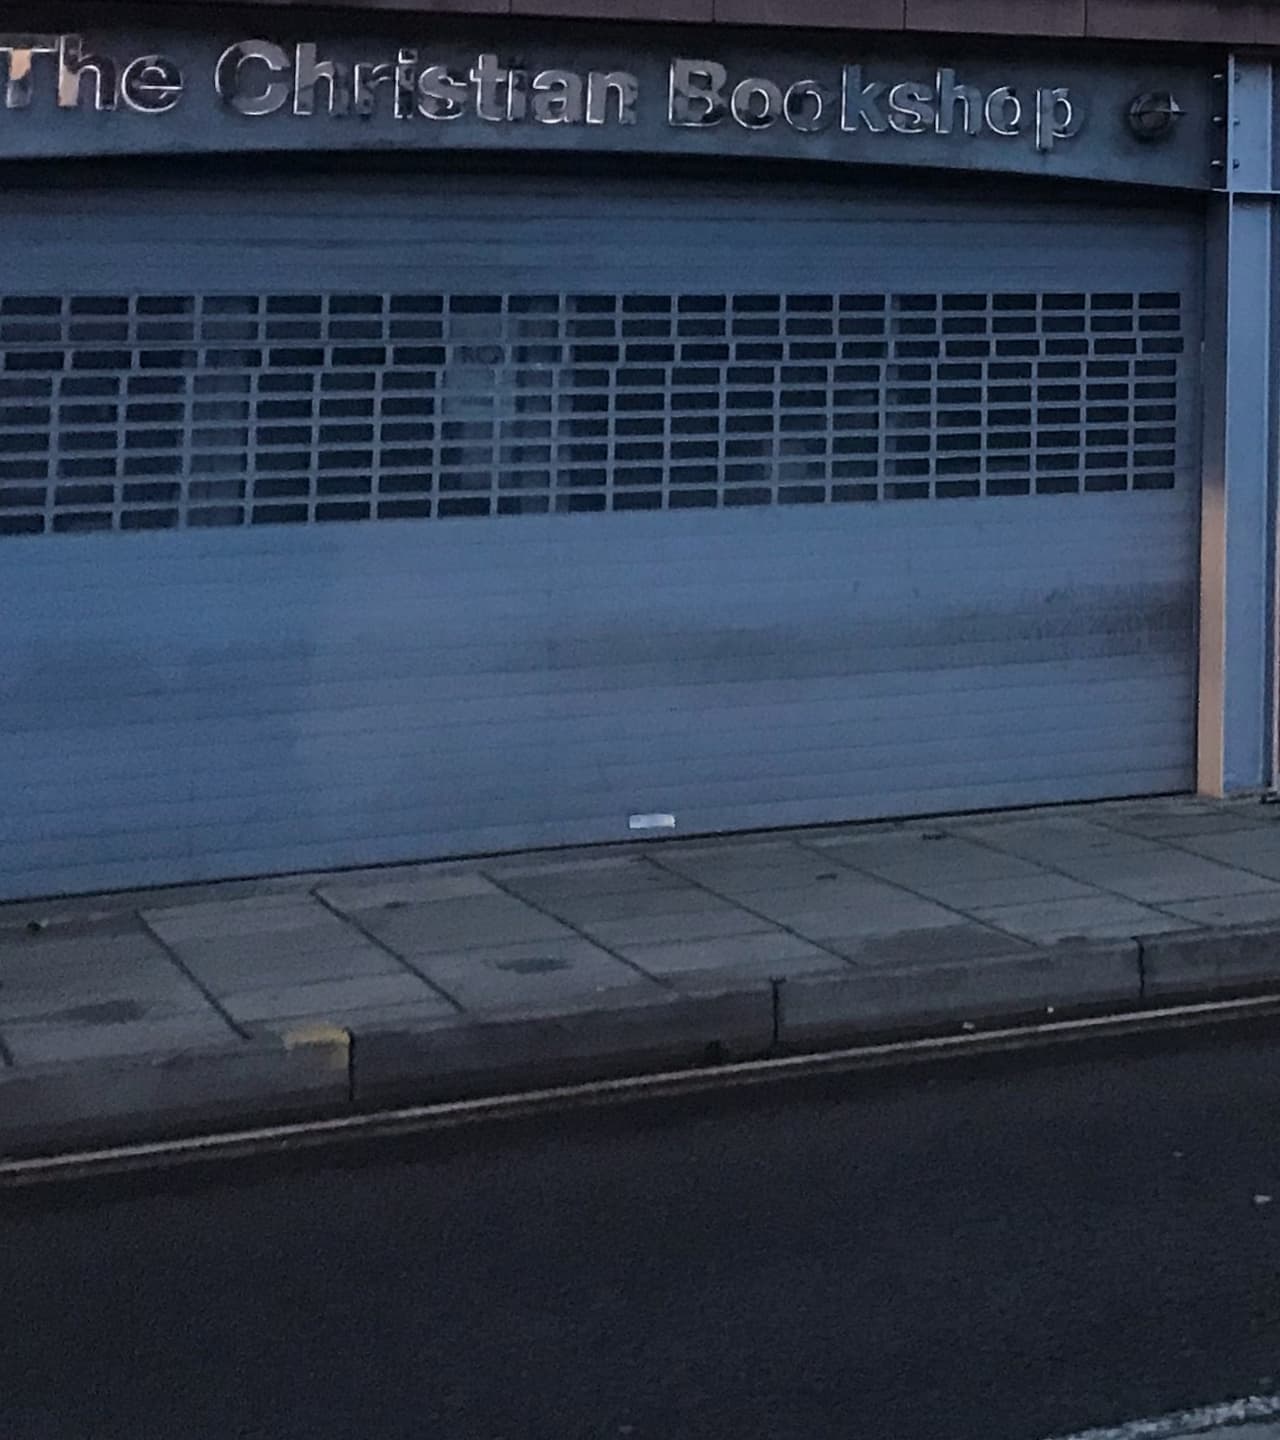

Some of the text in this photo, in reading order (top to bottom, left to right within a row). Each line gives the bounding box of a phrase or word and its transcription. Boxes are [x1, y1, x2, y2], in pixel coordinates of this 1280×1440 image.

[0, 34, 1086, 150] The Christian Bookshop
